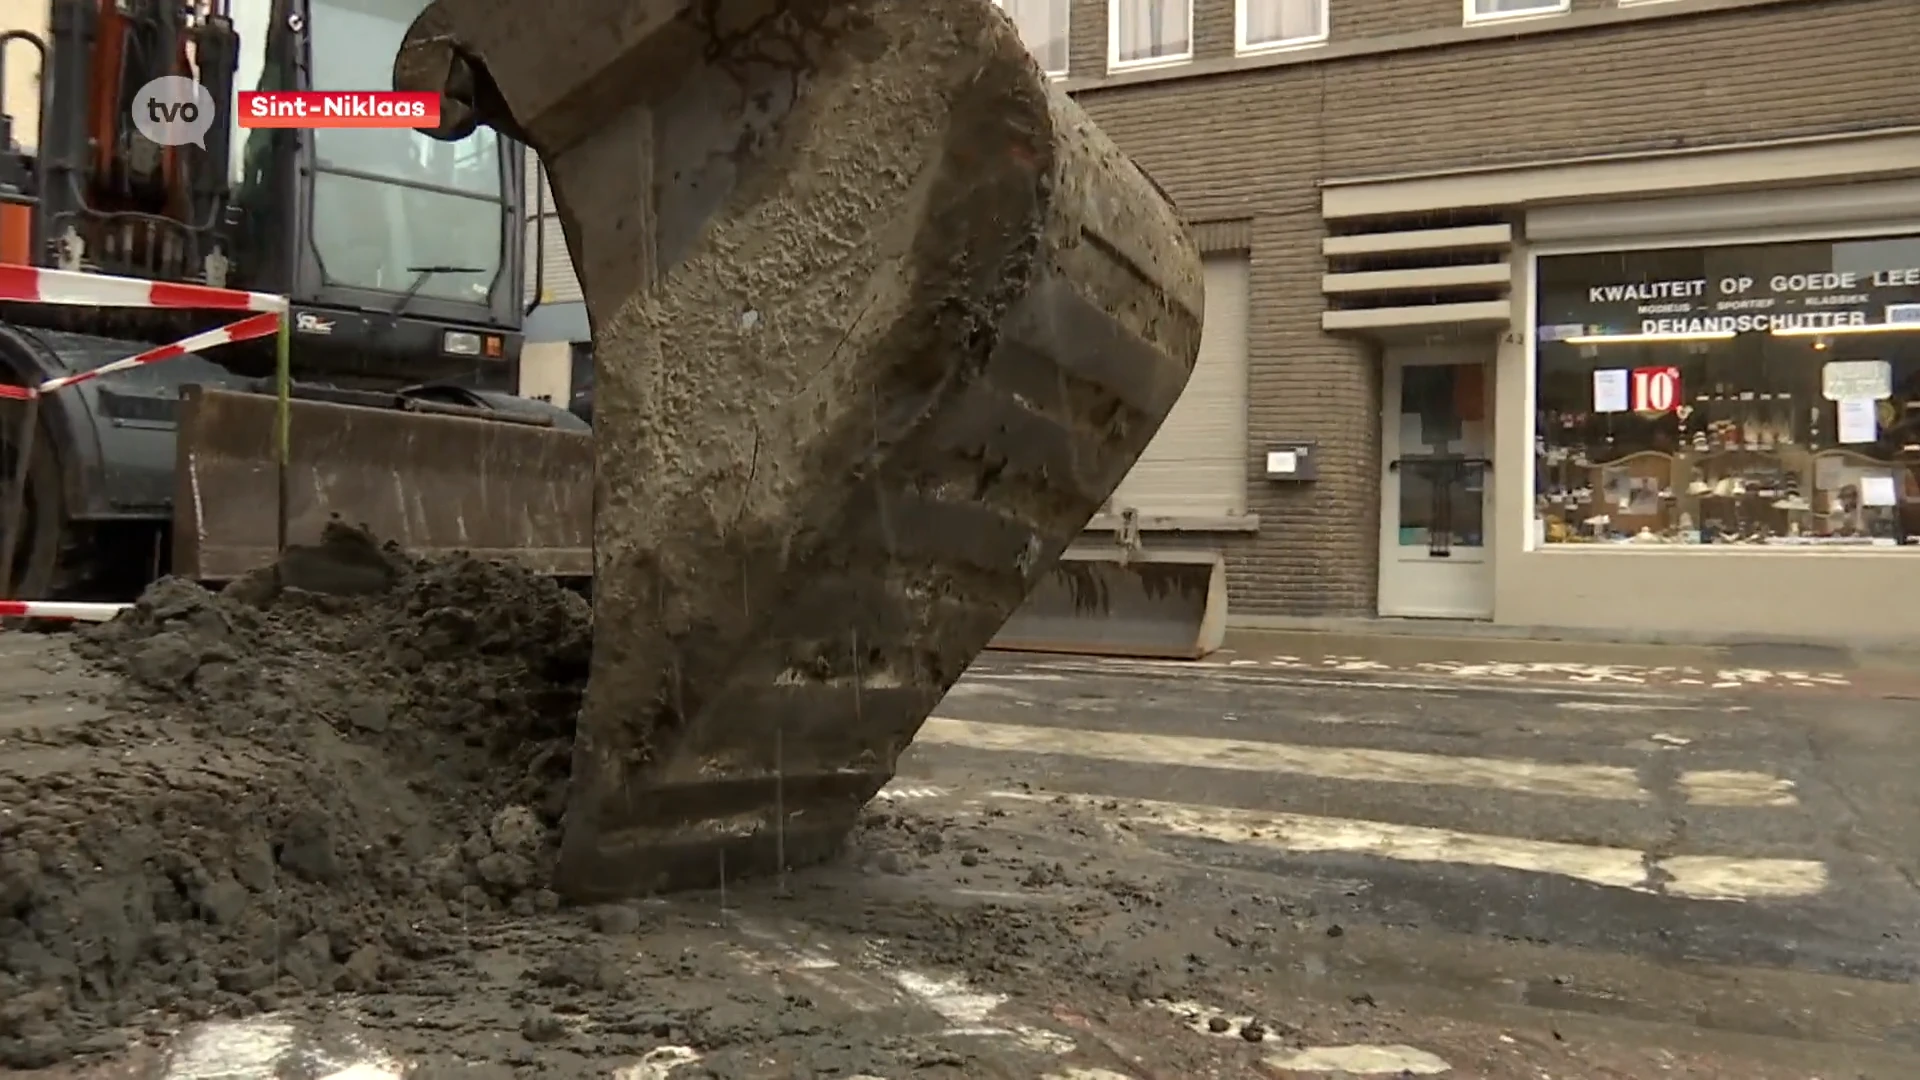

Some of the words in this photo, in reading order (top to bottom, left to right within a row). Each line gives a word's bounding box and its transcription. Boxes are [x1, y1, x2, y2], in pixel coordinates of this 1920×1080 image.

[1588, 279, 1706, 302] KWALITEIT
[1719, 277, 1753, 295] OP
[1770, 272, 1857, 292] GOEDE
[1872, 268, 1920, 288] LEE
[1641, 311, 1866, 335] DEHANDSCHUTTER
